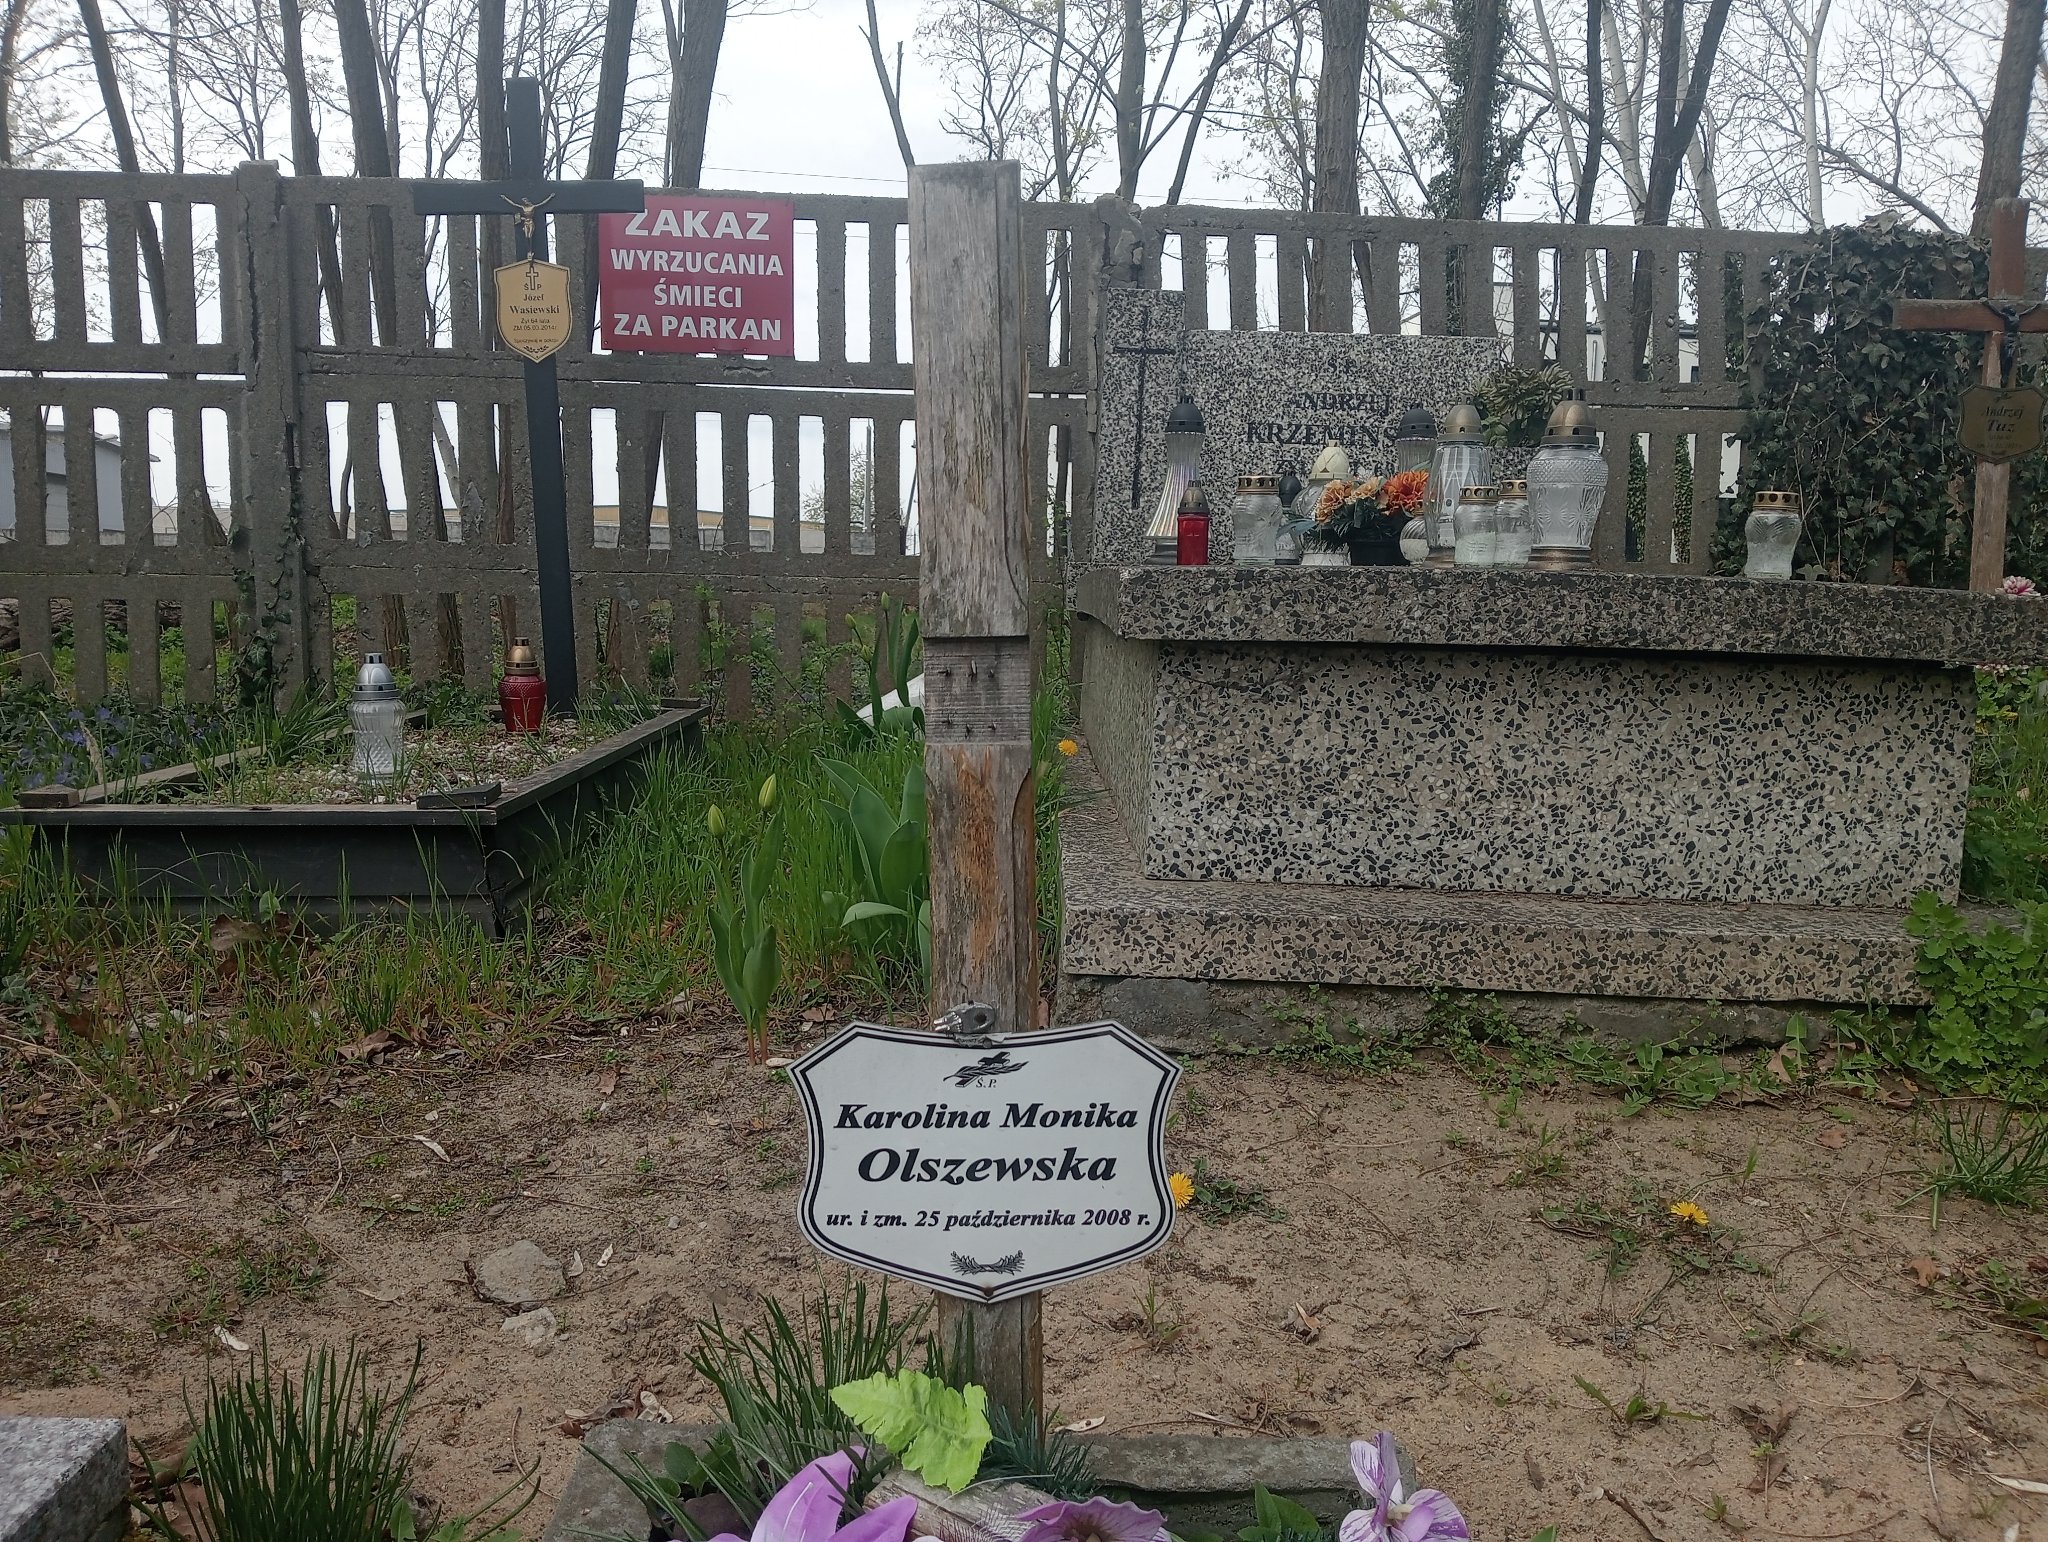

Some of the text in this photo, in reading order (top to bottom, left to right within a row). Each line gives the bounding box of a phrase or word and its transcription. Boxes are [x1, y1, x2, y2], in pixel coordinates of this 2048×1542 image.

[625, 208, 770, 241] ZAKAZ
[610, 248, 784, 276] WYRZUCANIA
[523, 293, 545, 302] Józef
[653, 277, 743, 308] ŚMIECI
[509, 304, 560, 315] Wasiewski
[613, 313, 782, 341] ZA PARKAN
[833, 1102, 1138, 1129] Karolina Monika
[858, 1147, 1118, 1186] Olszewska
[826, 1208, 1151, 1232] ur. i zm. 25 października 2008 r.
